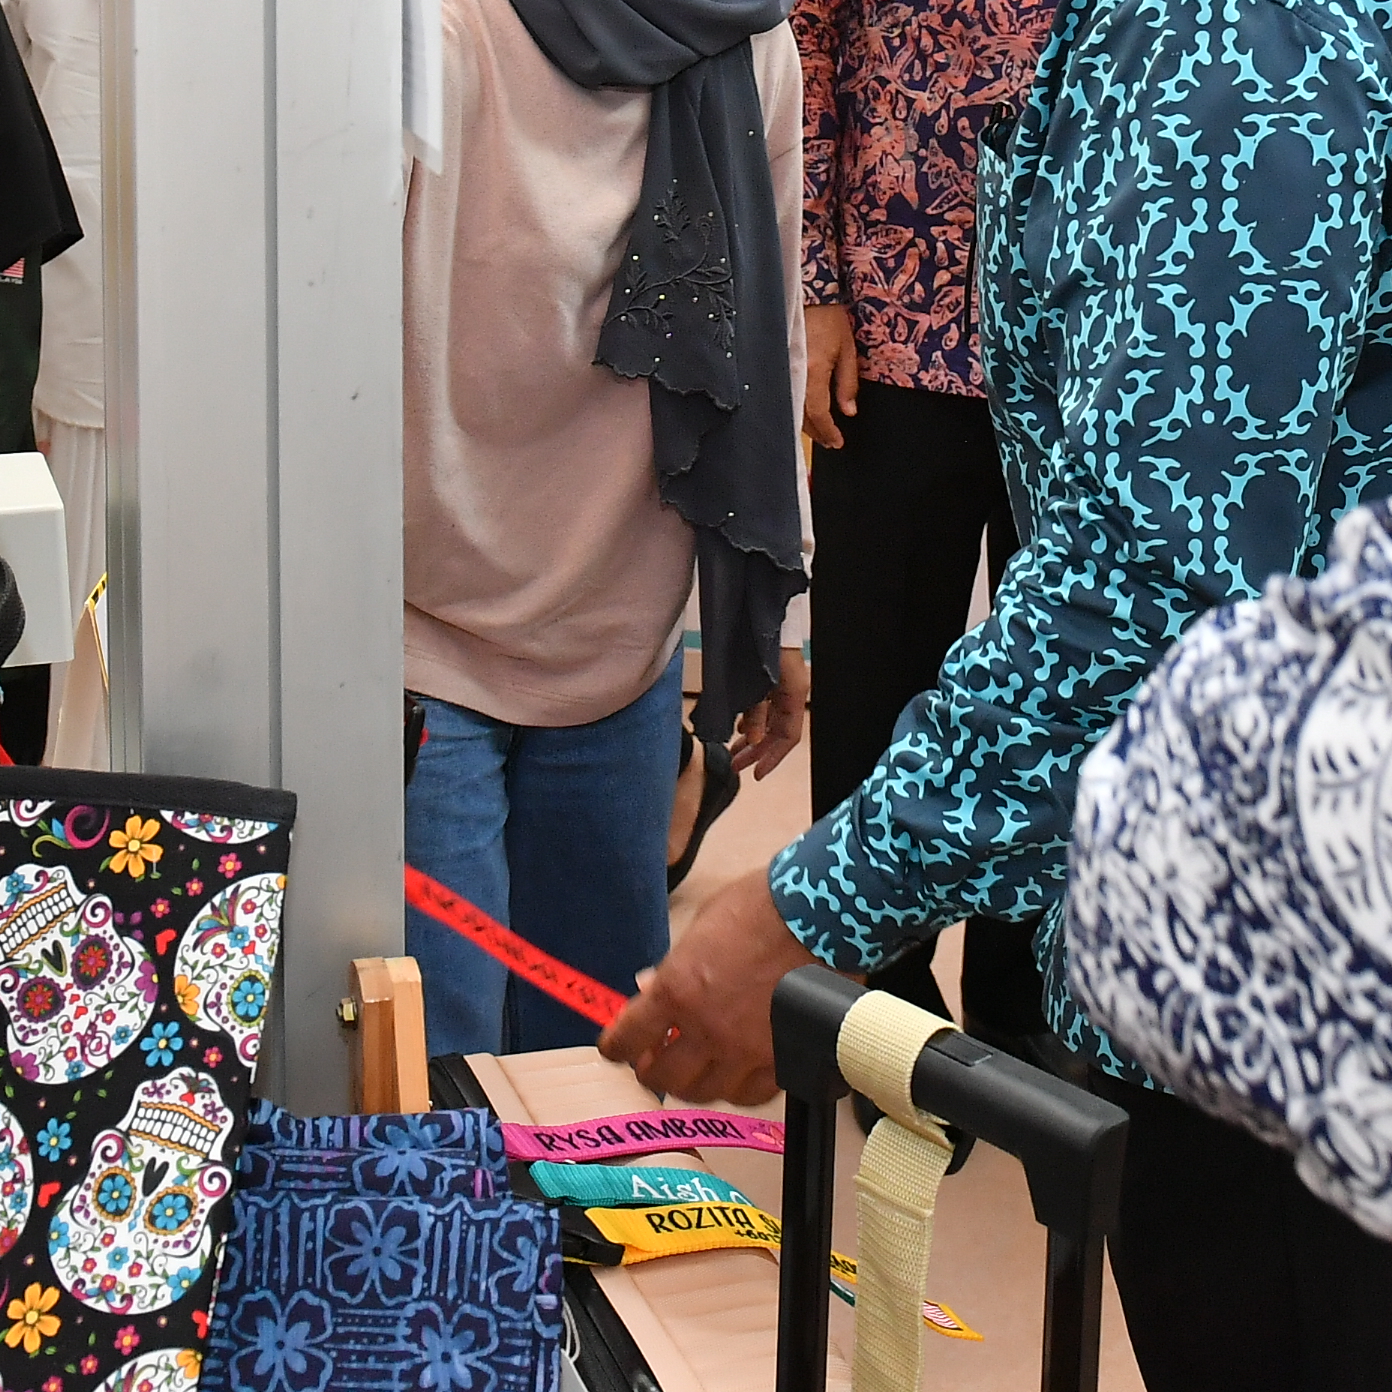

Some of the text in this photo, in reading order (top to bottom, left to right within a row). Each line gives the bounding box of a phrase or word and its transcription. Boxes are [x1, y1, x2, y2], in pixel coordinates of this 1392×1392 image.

[534, 1118, 746, 1154] RYSA AMBARI
[644, 1205, 756, 1234] ROZITA
